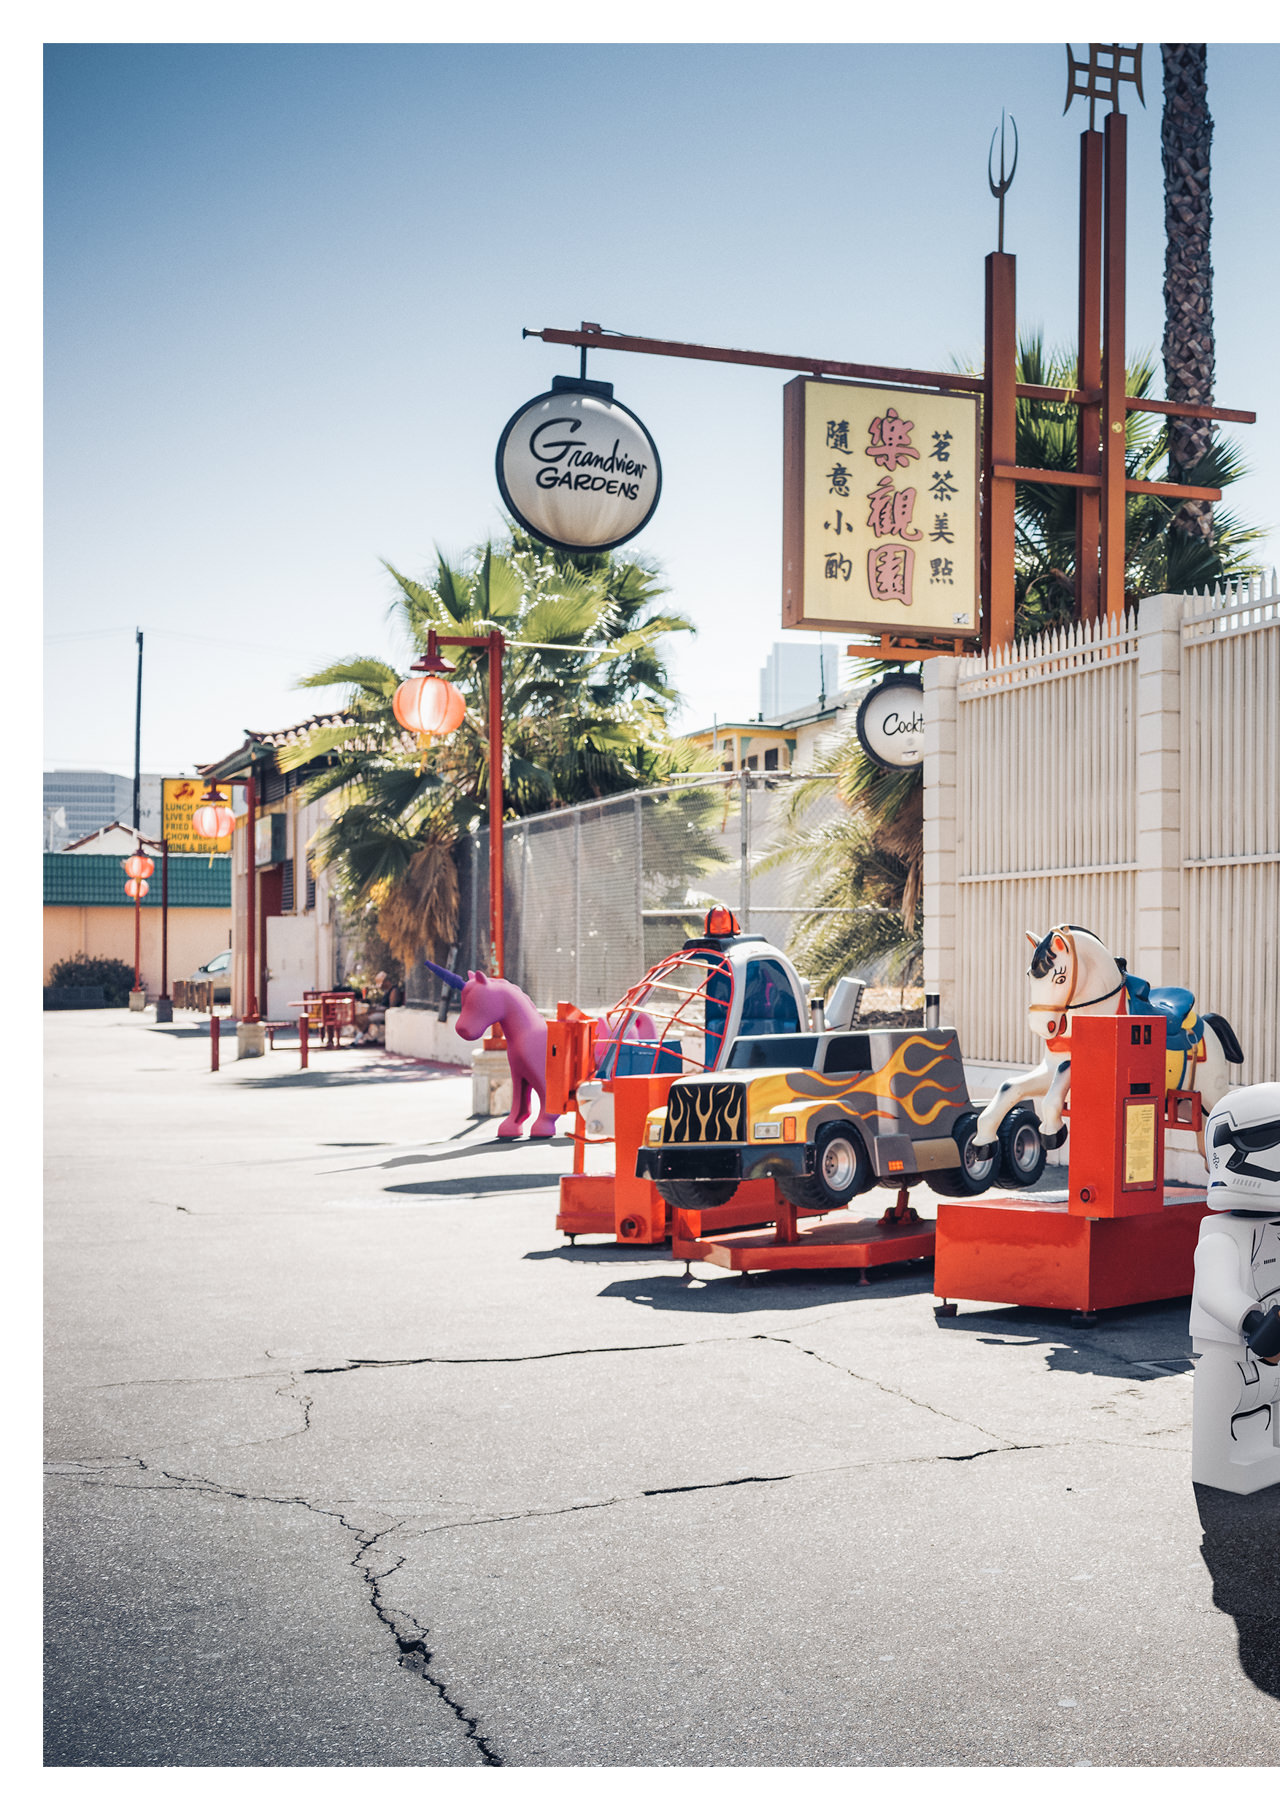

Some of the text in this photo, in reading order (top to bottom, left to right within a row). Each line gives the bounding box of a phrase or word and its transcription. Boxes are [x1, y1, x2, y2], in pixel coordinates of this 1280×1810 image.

[529, 417, 647, 479] Grandview
[536, 467, 639, 500] GARDENS
[824, 419, 853, 581] 隨意小酌
[928, 430, 959, 585] 茗茶美點
[882, 711, 925, 736] Cockt
[165, 813, 183, 821] LIVE
[165, 823, 189, 831] FRIED
[165, 832, 189, 841] CHOW
[167, 843, 186, 852] WINE
